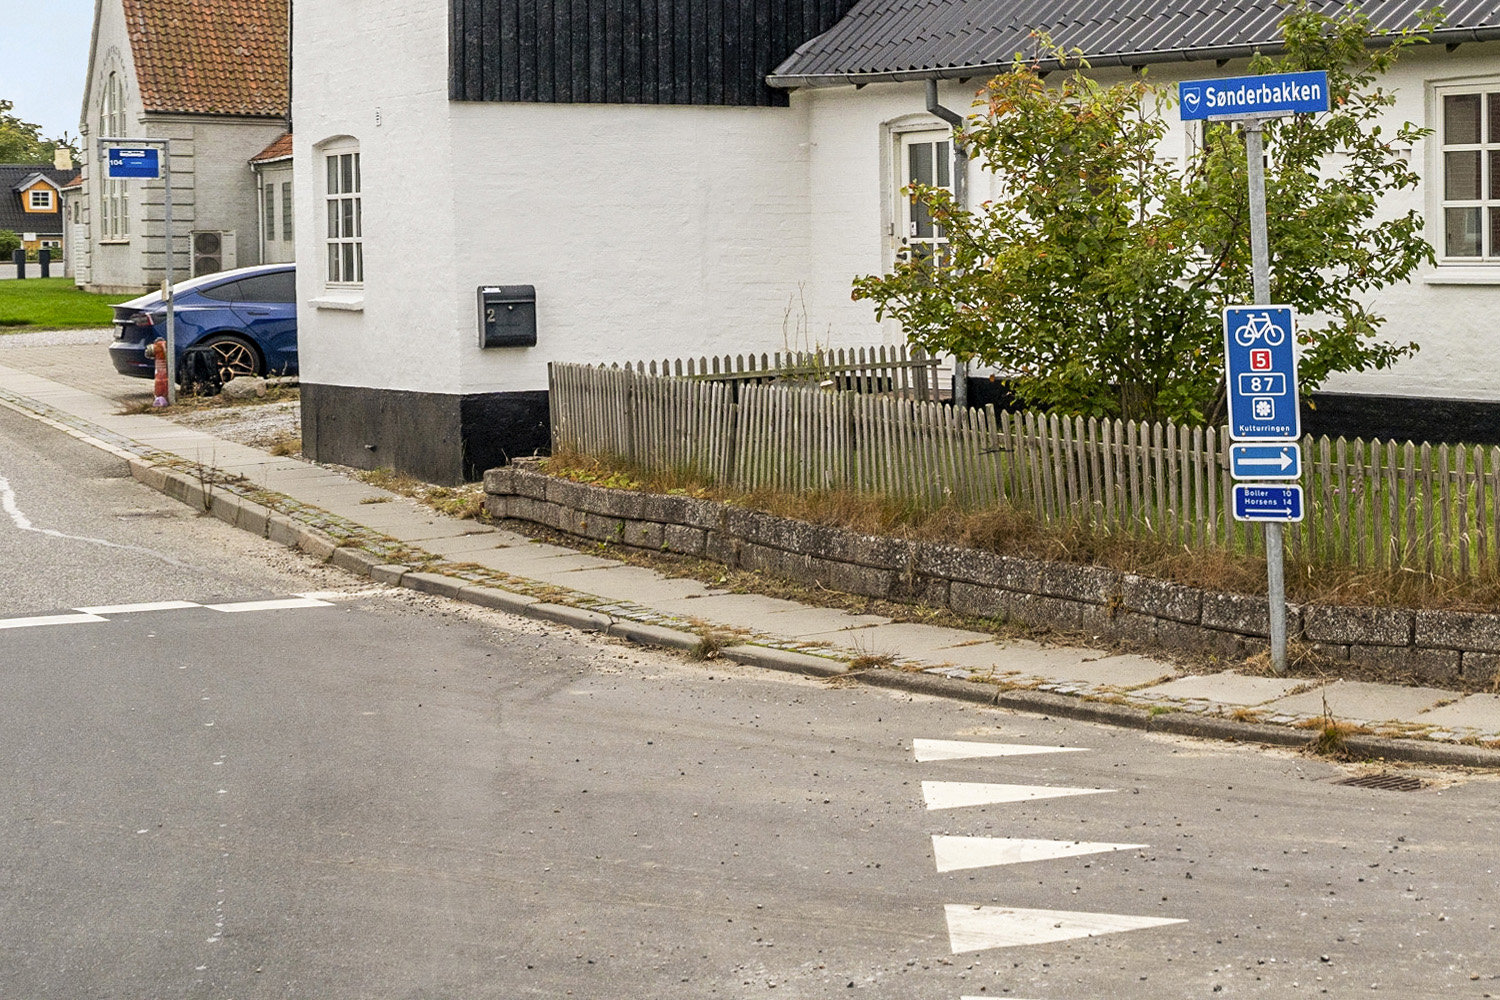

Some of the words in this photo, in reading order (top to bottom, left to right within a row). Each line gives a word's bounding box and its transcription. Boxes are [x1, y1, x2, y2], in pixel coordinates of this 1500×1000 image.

[1205, 80, 1321, 108] Sønderbakken
[486, 308, 496, 323] 2
[1256, 352, 1267, 368] 5
[1251, 377, 1274, 392] 87
[1239, 424, 1290, 433] Kulturringen
[1244, 489, 1268, 497] Boller
